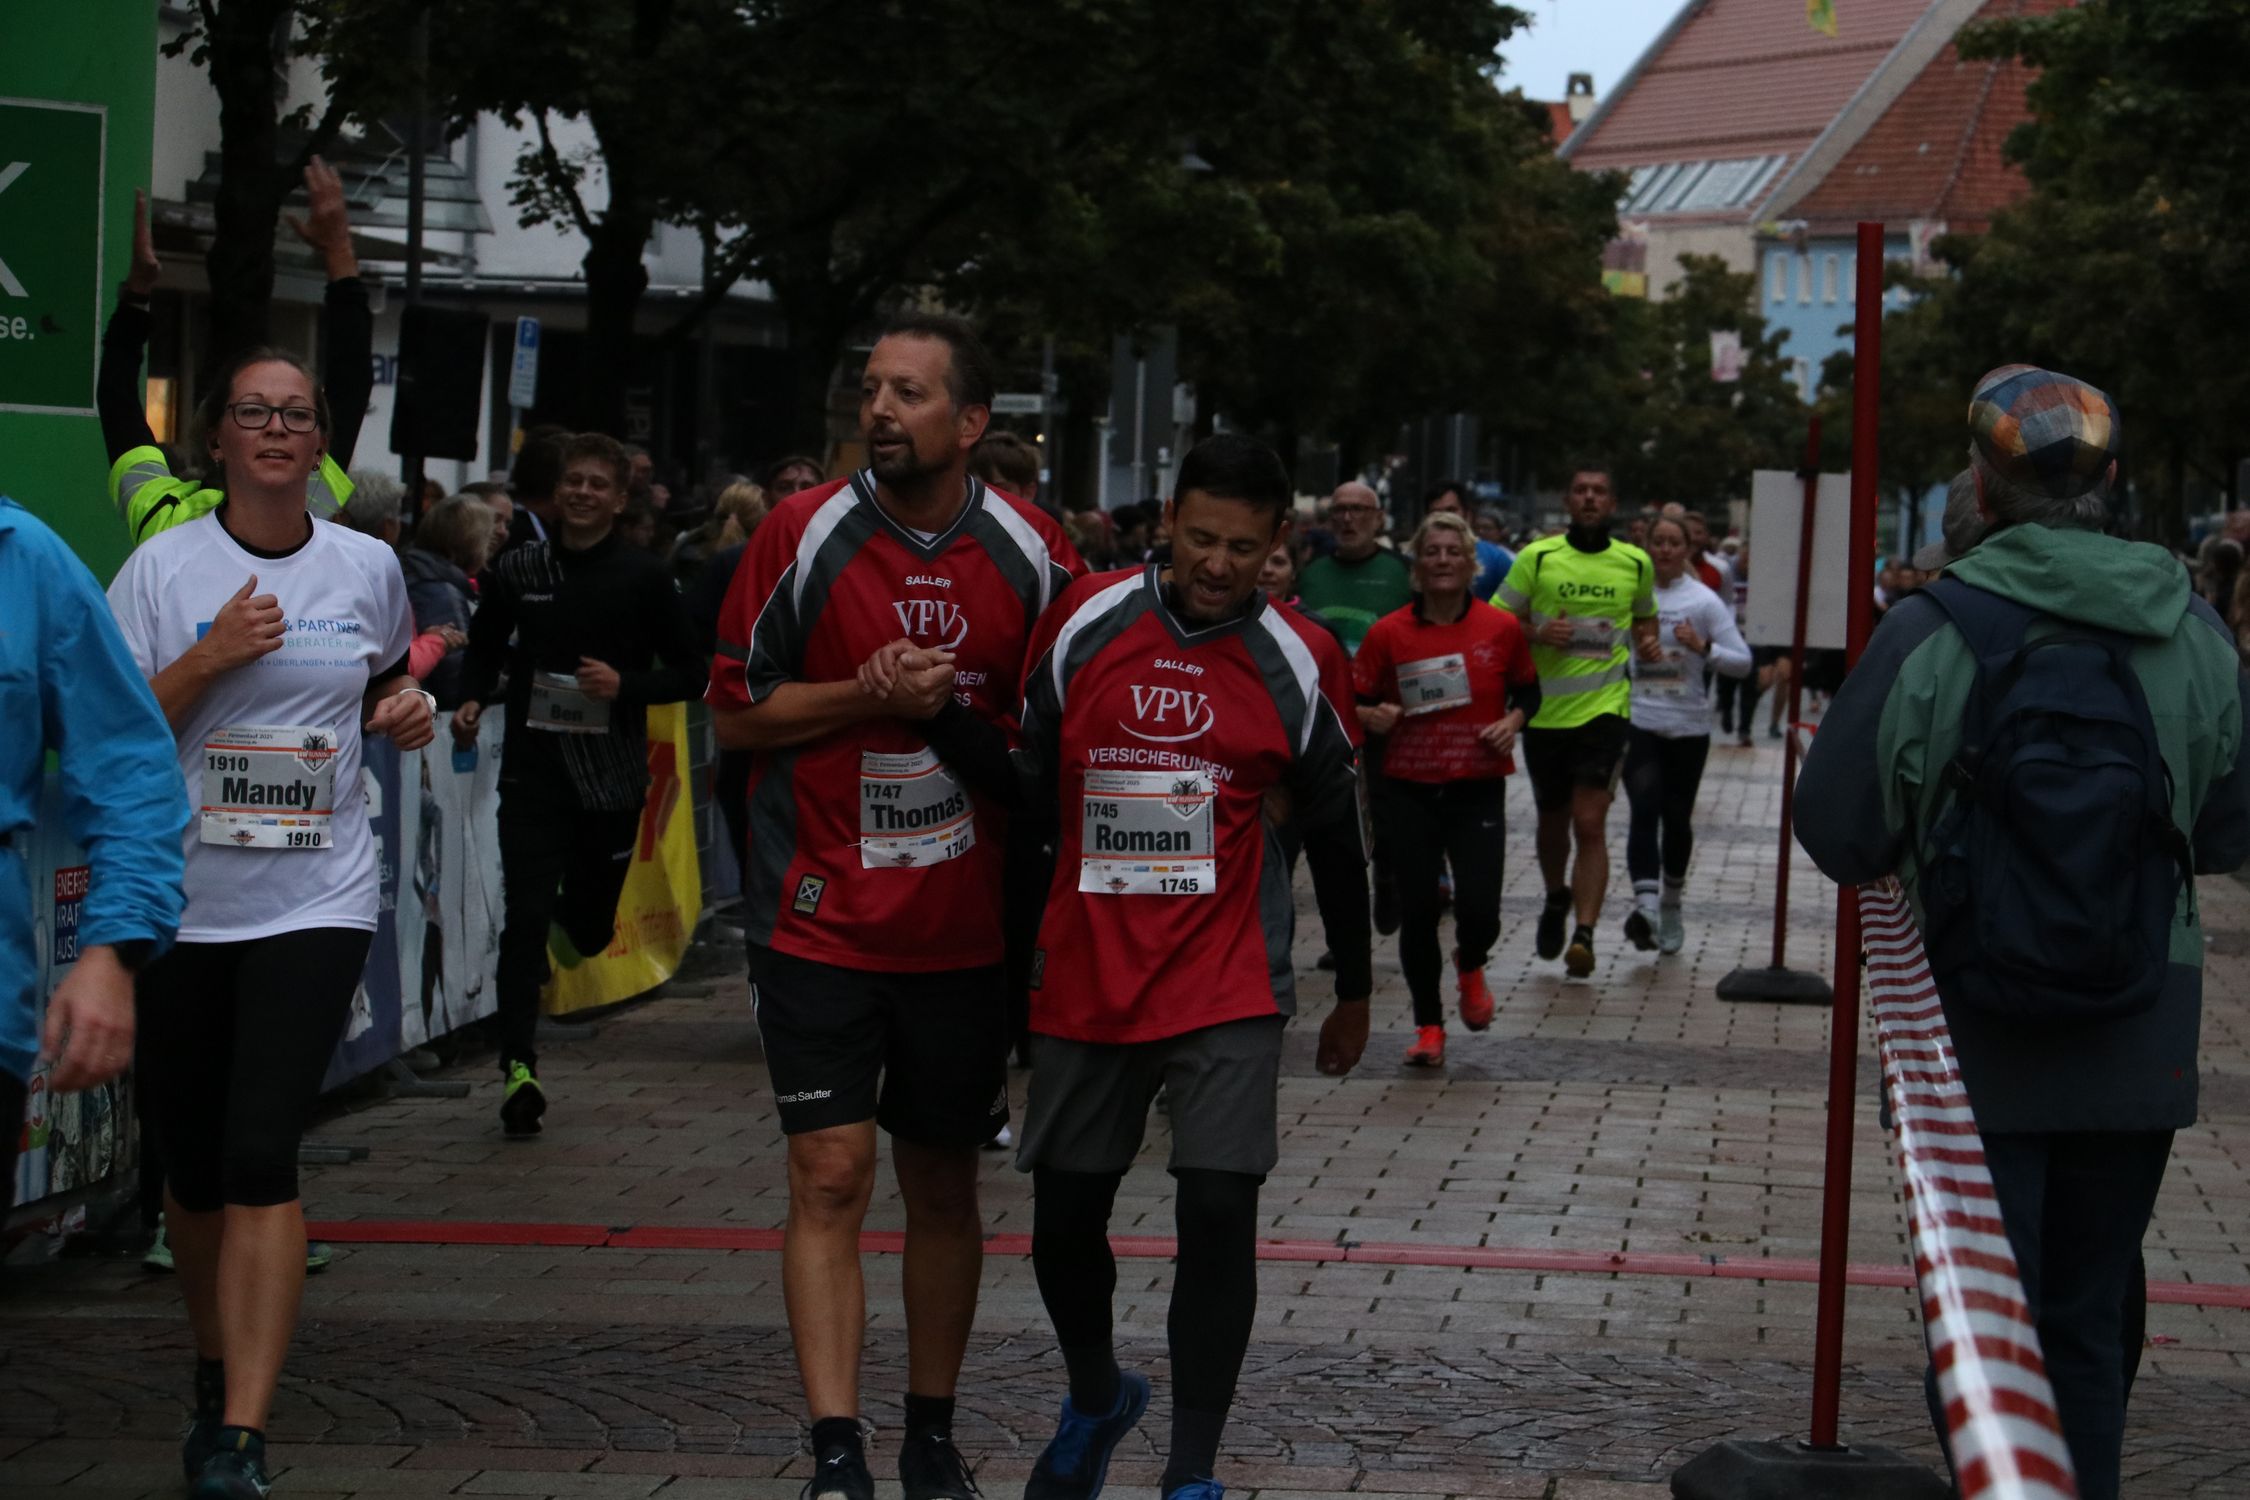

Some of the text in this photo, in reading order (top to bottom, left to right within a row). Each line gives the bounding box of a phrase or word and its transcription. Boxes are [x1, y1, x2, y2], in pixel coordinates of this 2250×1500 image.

[905, 575, 951, 588] SALLER
[1579, 585, 1615, 597] PCH
[892, 600, 960, 637] VPV
[298, 619, 361, 635] PARTNER
[1153, 659, 1204, 677] SALLER
[1420, 686, 1444, 701] Ina
[550, 704, 583, 721] Ben
[1130, 685, 1208, 728] VPV
[208, 755, 249, 771] 1910
[1088, 747, 1234, 783] VERSICHERUNGEN
[222, 777, 316, 811] Mandy
[863, 784, 902, 799] 1747
[870, 792, 965, 829] Thomas
[1086, 802, 1118, 818] 1745
[286, 832, 321, 846] 1910
[1096, 824, 1191, 852] Roman
[945, 835, 968, 858] 1747
[1159, 878, 1199, 892] 1745
[797, 1089, 832, 1102] Sautter
